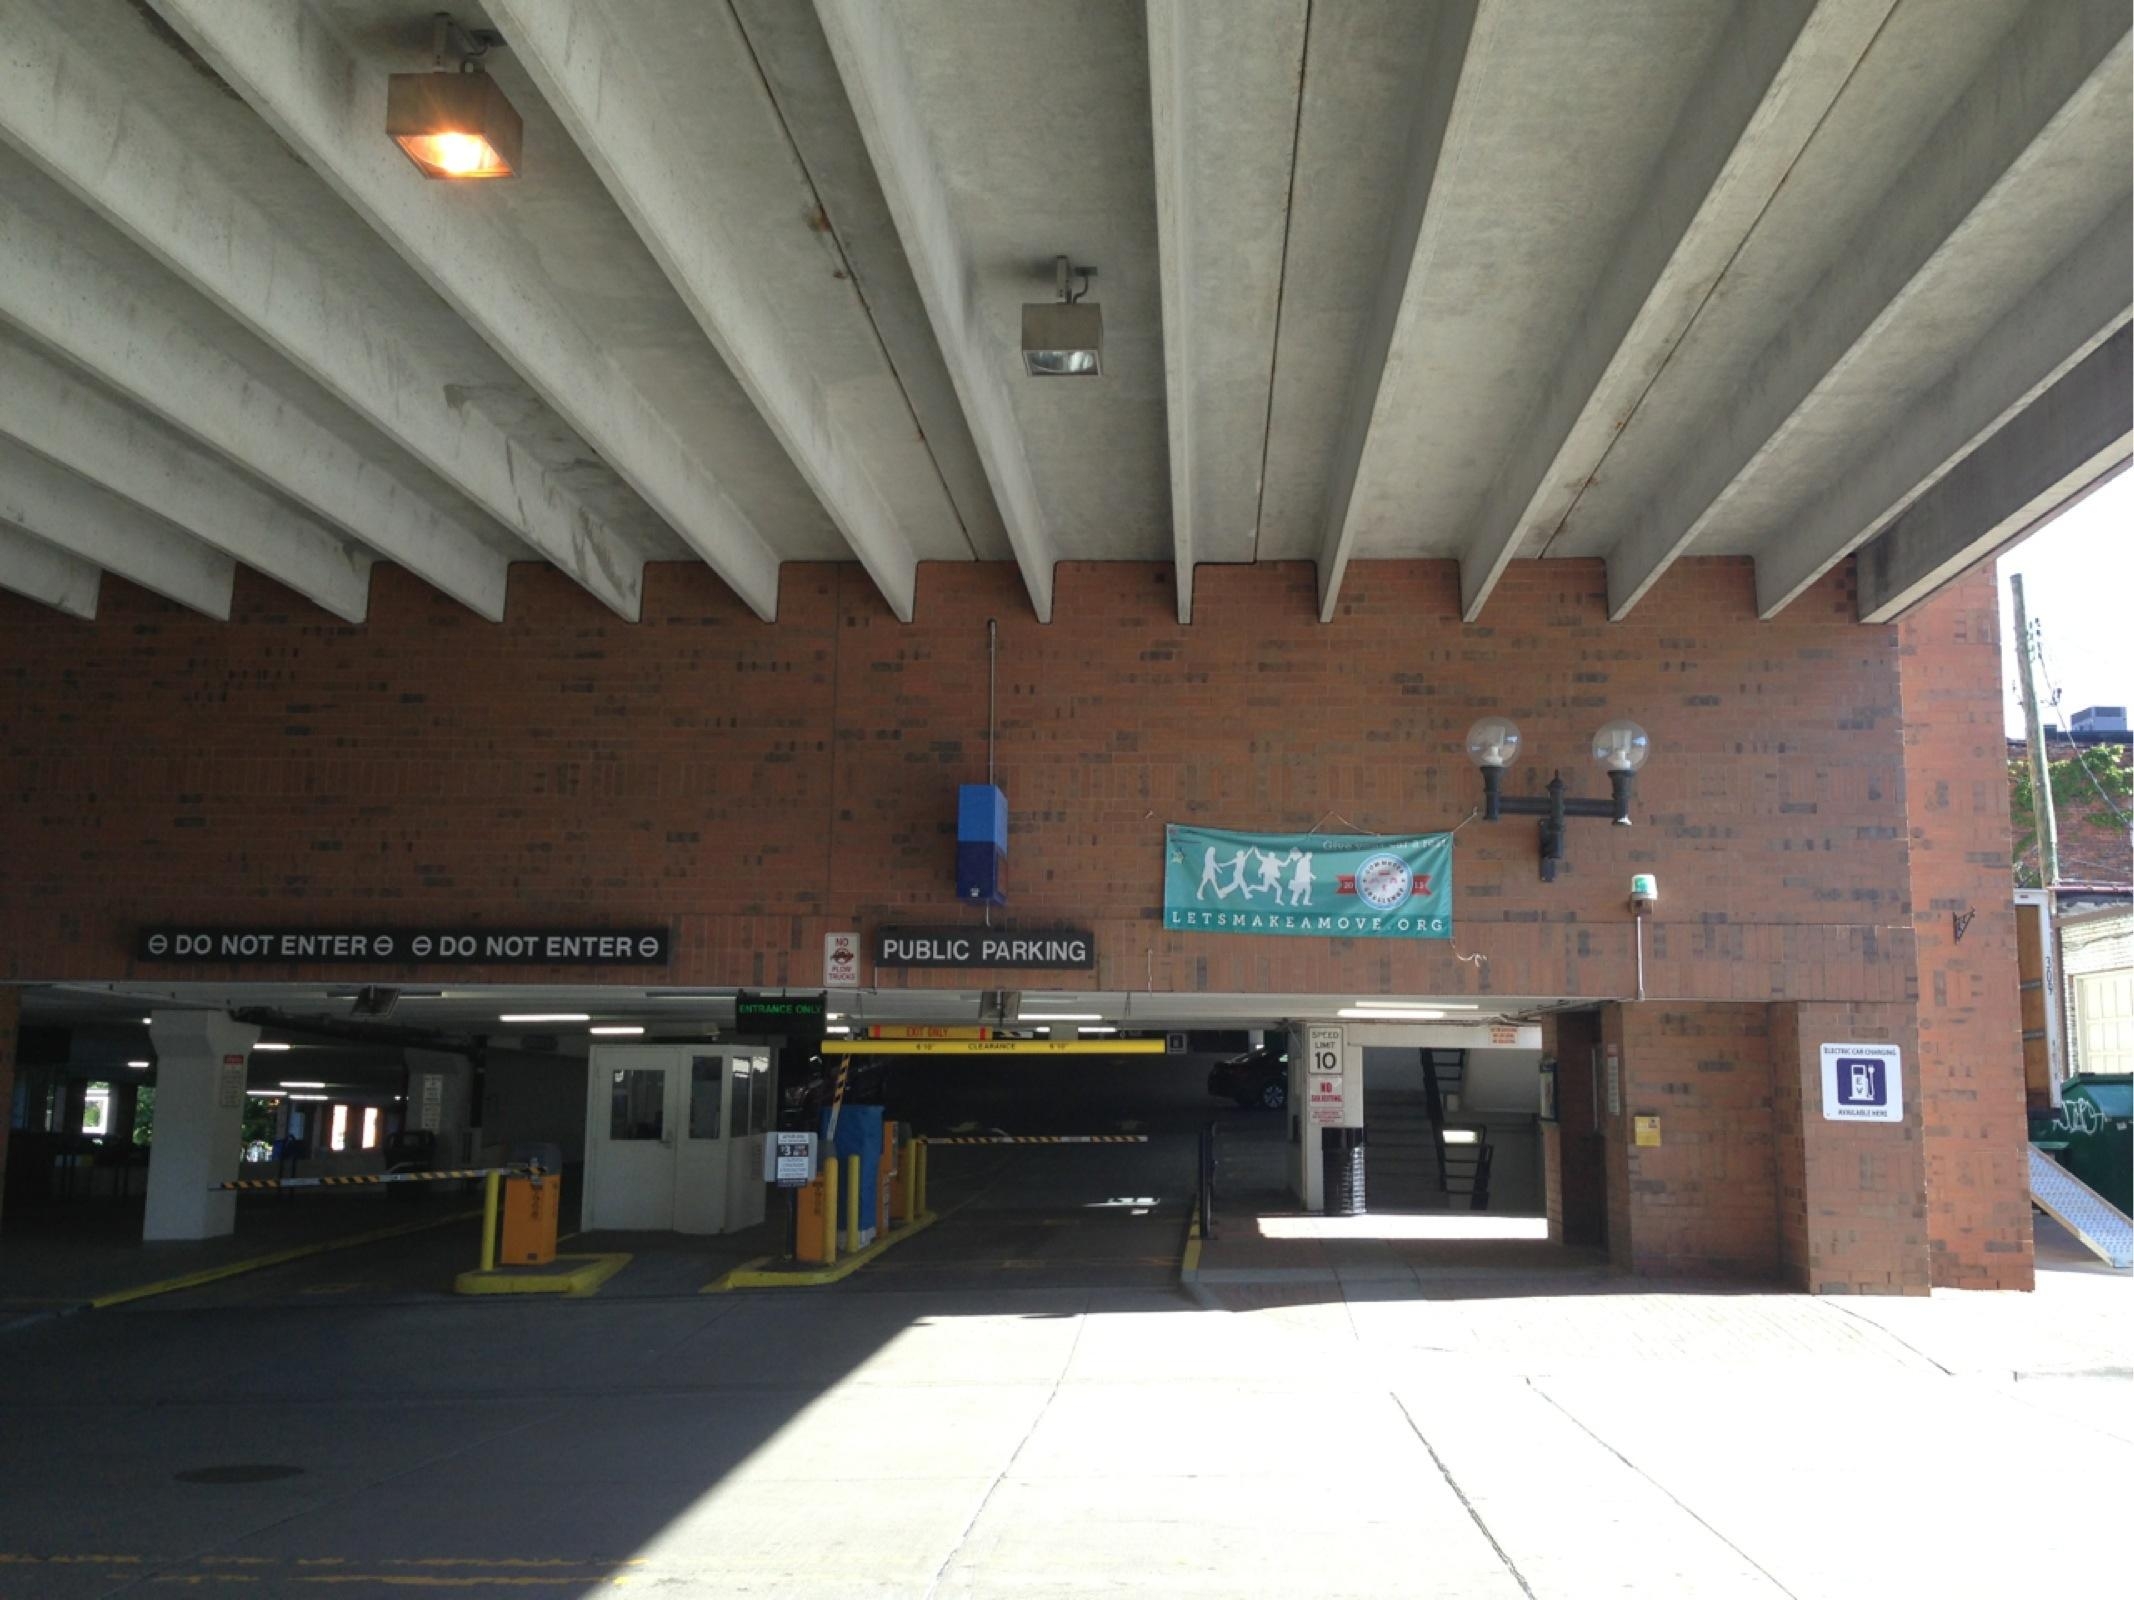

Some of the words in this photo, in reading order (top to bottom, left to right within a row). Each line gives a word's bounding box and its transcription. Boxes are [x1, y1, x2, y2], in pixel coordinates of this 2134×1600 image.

[175, 935, 212, 954] DO
[221, 935, 274, 955] NOT
[280, 935, 367, 955] ENTER
[439, 936, 477, 956] DO
[486, 936, 539, 957] NOT
[546, 936, 632, 957] ENTER
[835, 937, 849, 947] NO
[883, 940, 970, 960] PUBLIC
[982, 941, 1086, 961] PARKING
[740, 1003, 793, 1014] ENTRANCE
[795, 1004, 821, 1014] ONLY
[968, 1043, 1016, 1051] CLEARANCE
[1824, 1047, 1850, 1055] ELECTRIC
[1315, 1052, 1337, 1070] 10
[1320, 1082, 1333, 1093] NO
[1838, 1109, 1871, 1117] AVAILABLE
[1872, 1110, 1888, 1118] HERE
